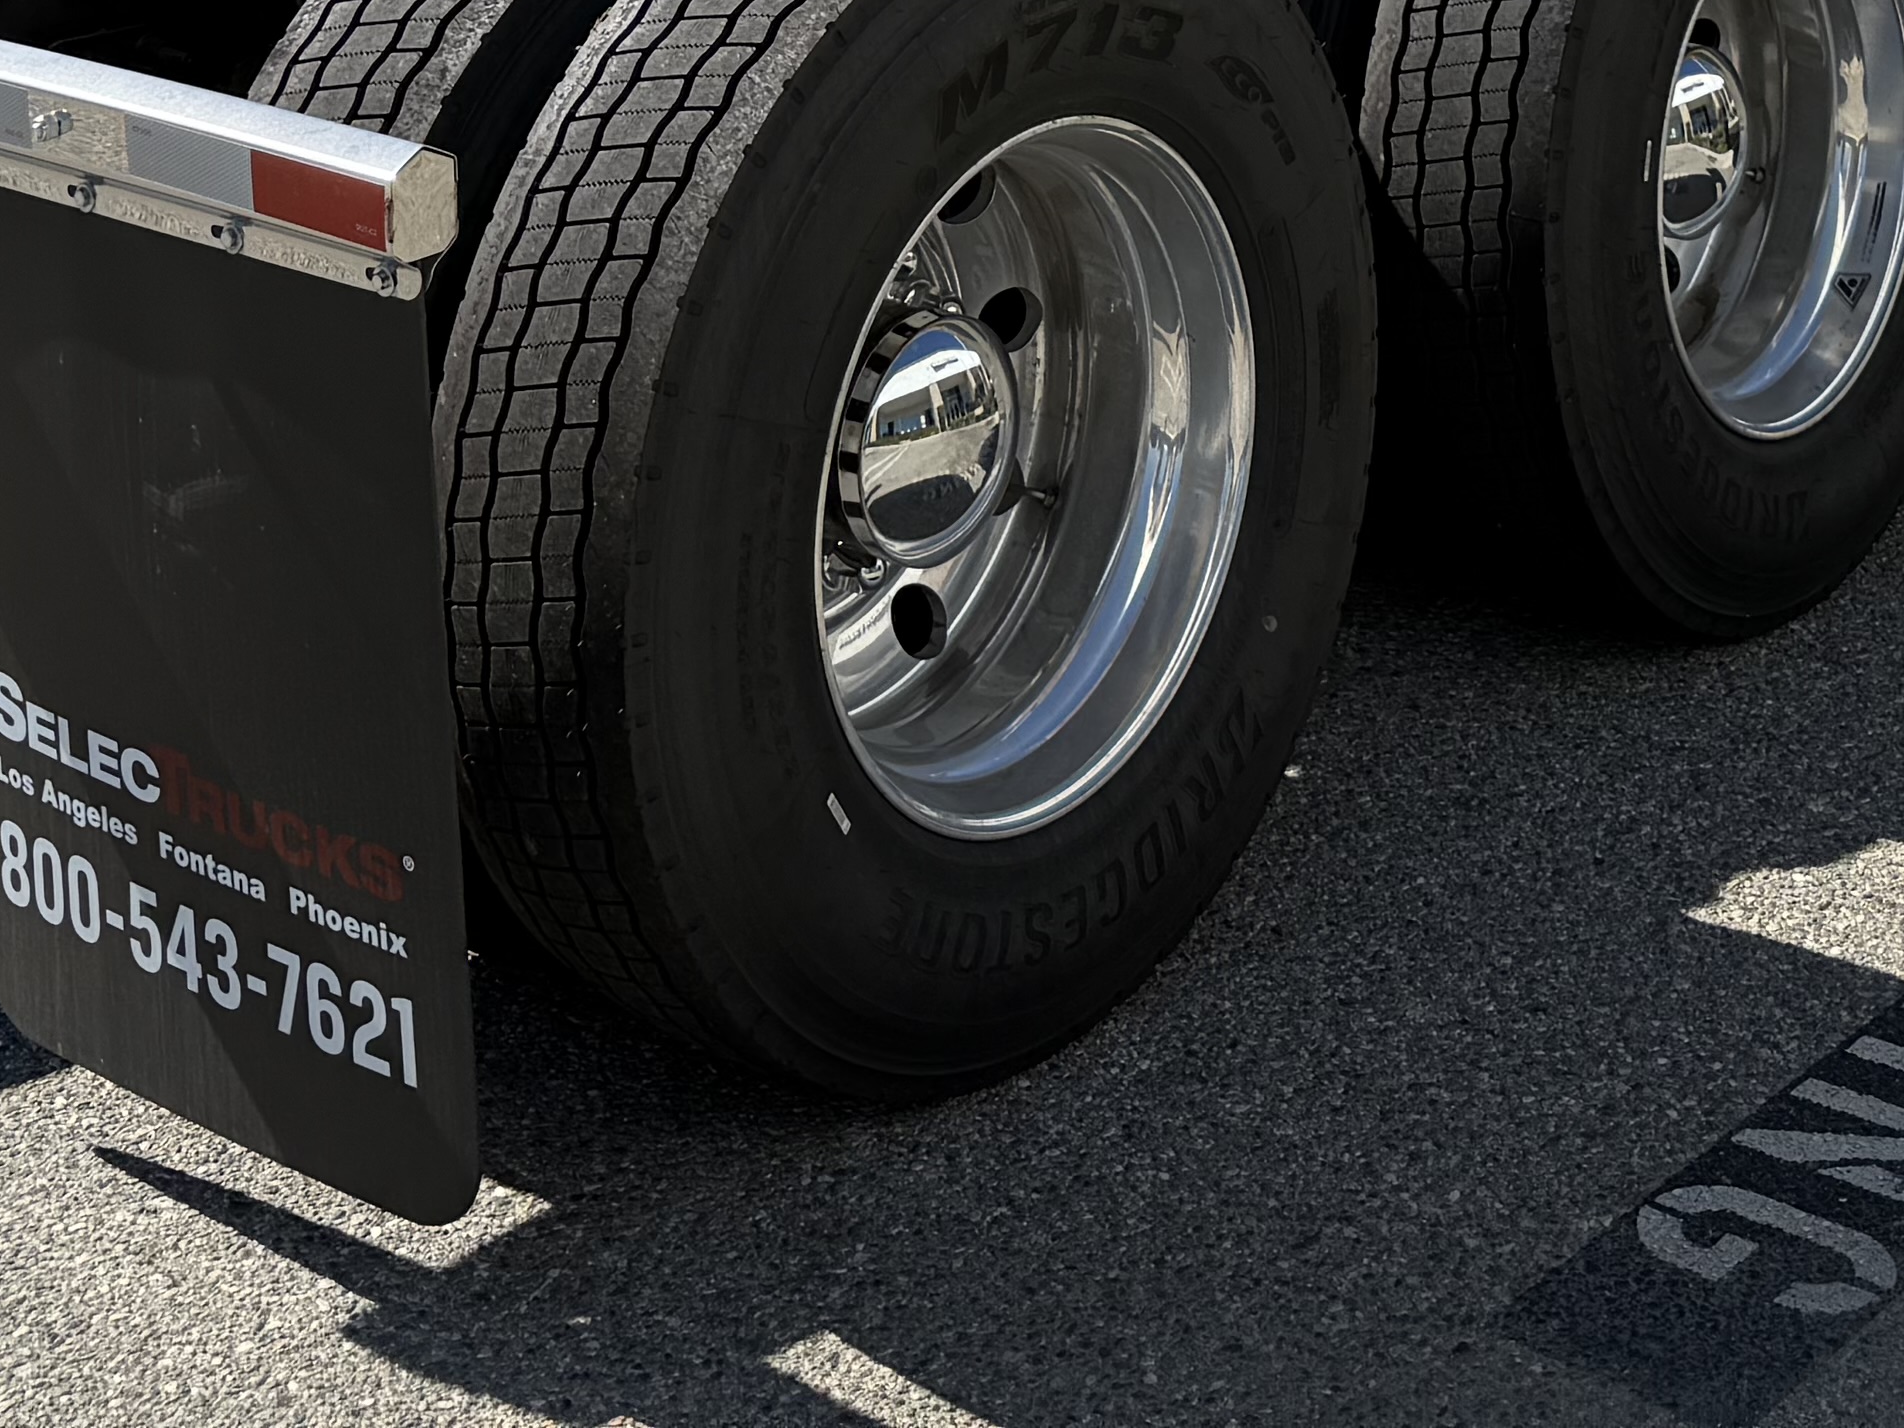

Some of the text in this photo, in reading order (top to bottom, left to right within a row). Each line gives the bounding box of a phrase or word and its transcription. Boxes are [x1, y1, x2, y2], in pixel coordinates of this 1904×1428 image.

[934, 2, 1185, 150] M713
[0, 818, 418, 1089] 800-543-7621
[41, 778, 139, 845] Angeles
[158, 830, 267, 903] Fontana
[288, 886, 409, 959] Phoenix
